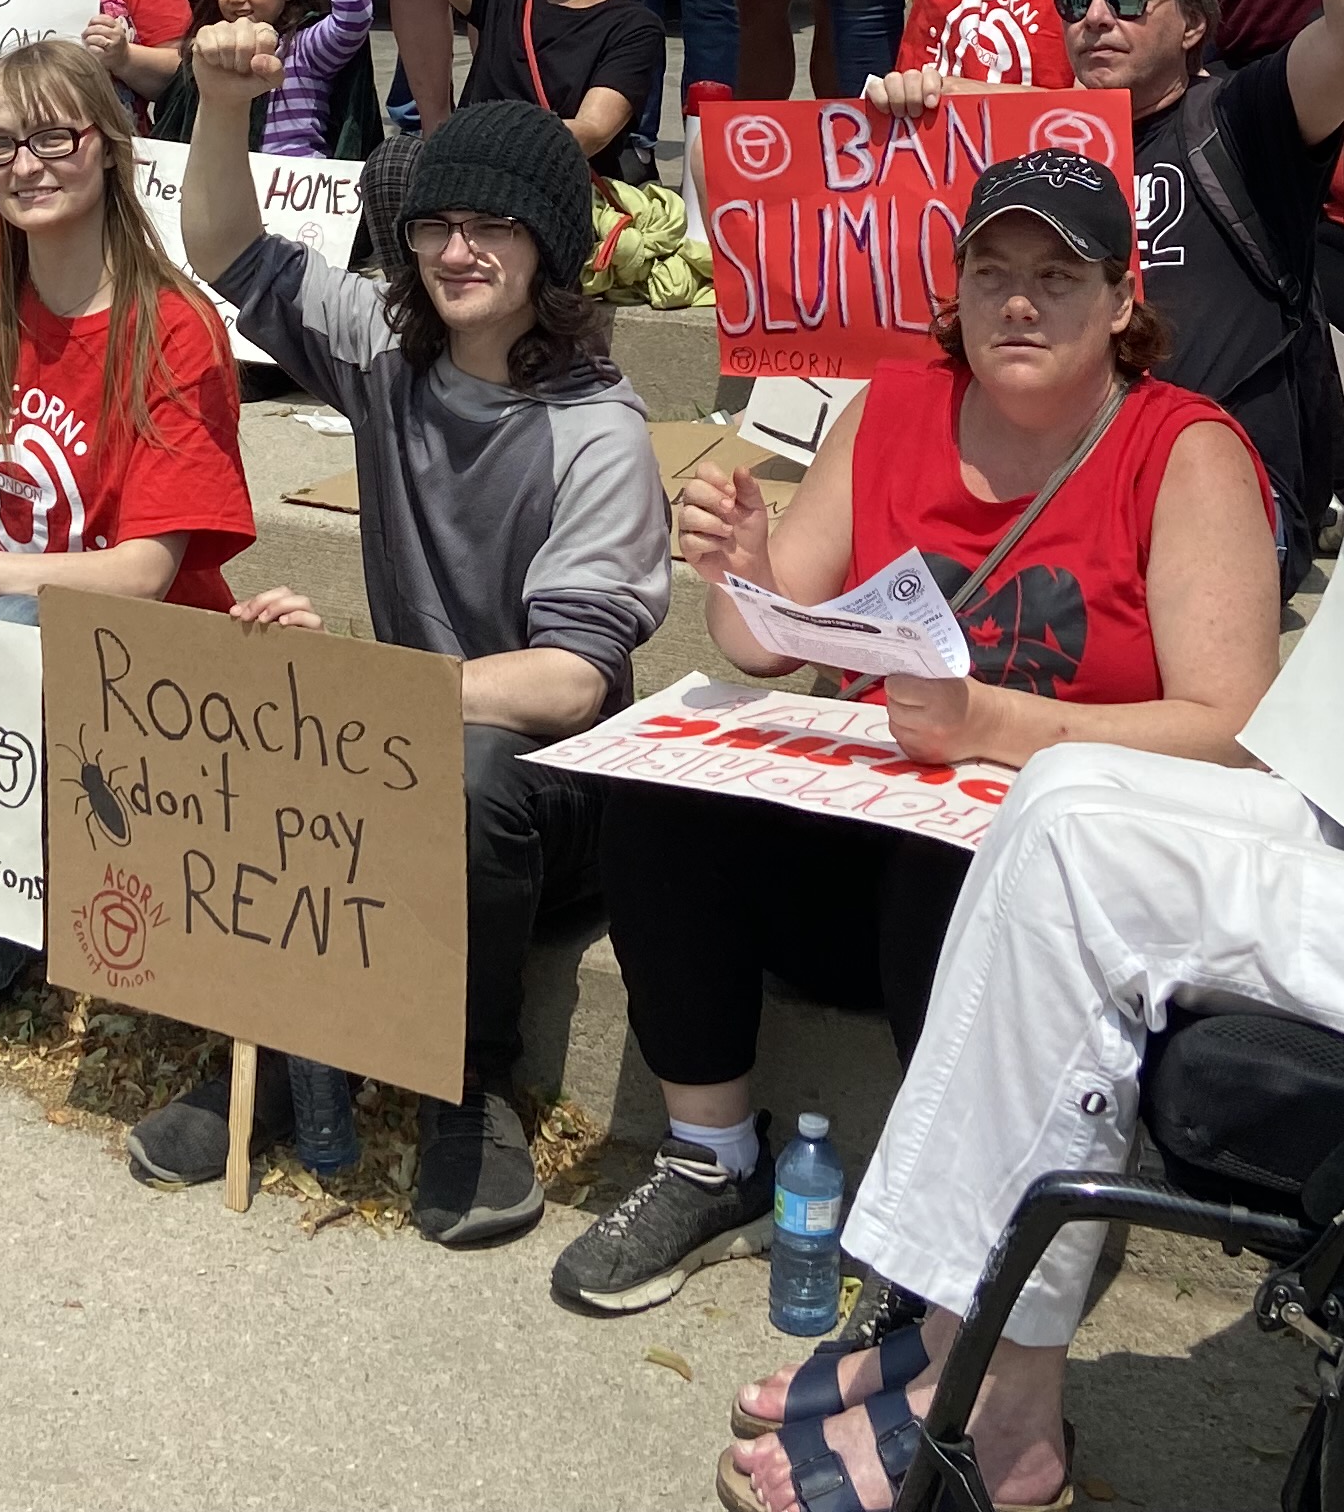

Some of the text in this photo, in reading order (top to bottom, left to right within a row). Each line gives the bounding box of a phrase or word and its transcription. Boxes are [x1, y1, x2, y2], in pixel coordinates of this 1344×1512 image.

[819, 98, 994, 192] BAN
[264, 167, 363, 216] HOMES
[760, 349, 843, 378] ACORN
[95, 627, 420, 792] Roaches
[130, 752, 365, 884] don't pay
[103, 863, 171, 928] ACORN
[184, 849, 386, 970] RENT
[71, 905, 102, 975] Tenant
